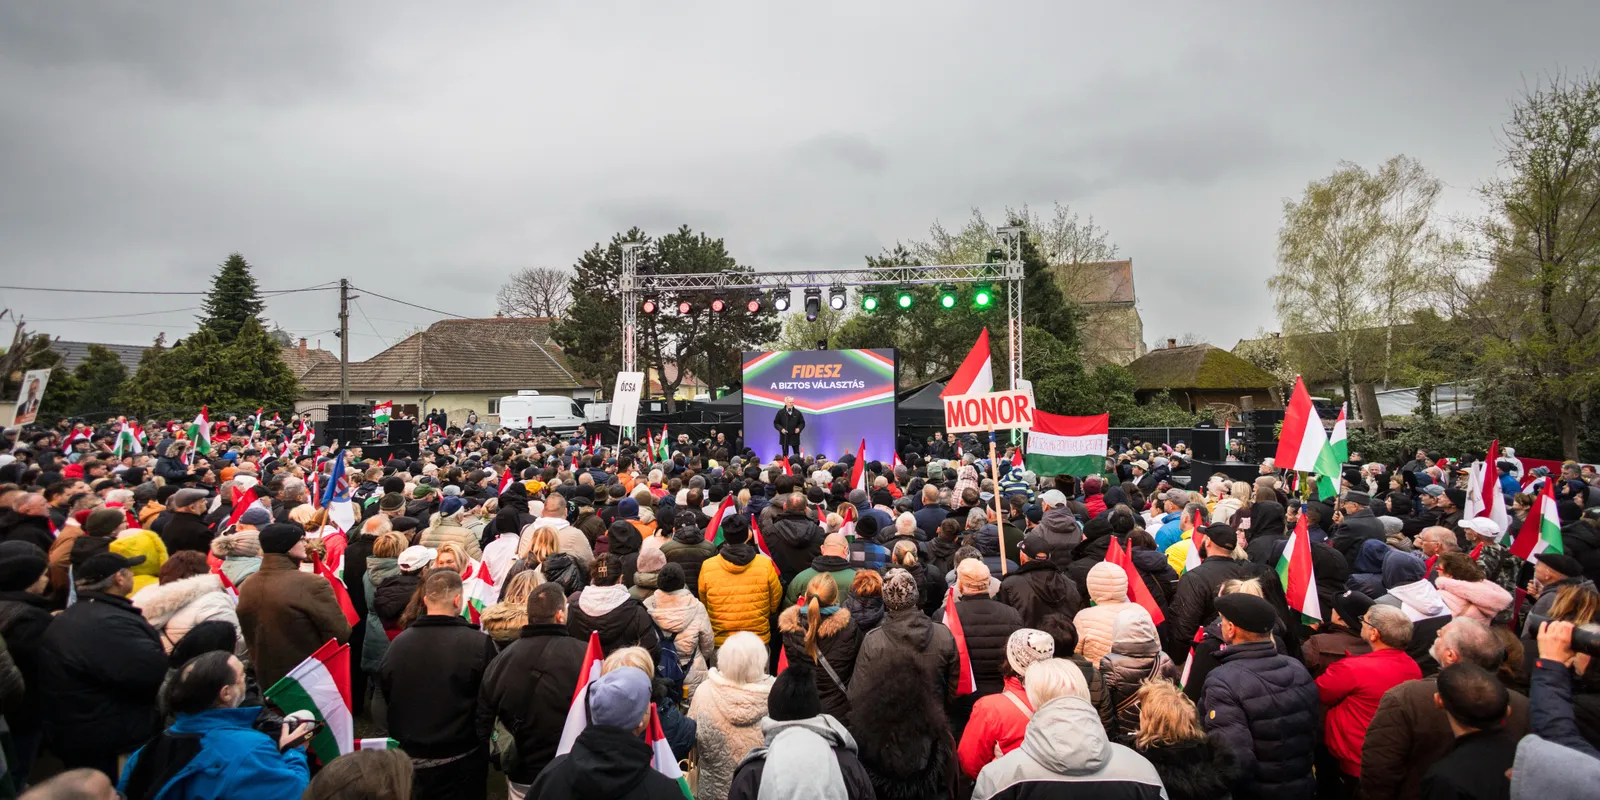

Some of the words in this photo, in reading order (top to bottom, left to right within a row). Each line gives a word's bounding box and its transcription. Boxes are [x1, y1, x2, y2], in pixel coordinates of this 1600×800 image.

[791, 364, 842, 378] FIDESZ
[620, 381, 636, 392] ÓCSA
[770, 382, 778, 390] A
[778, 382, 811, 390] BIZTOS
[812, 379, 865, 389] VÁLASZTÁS
[947, 395, 1031, 428] MONOR
